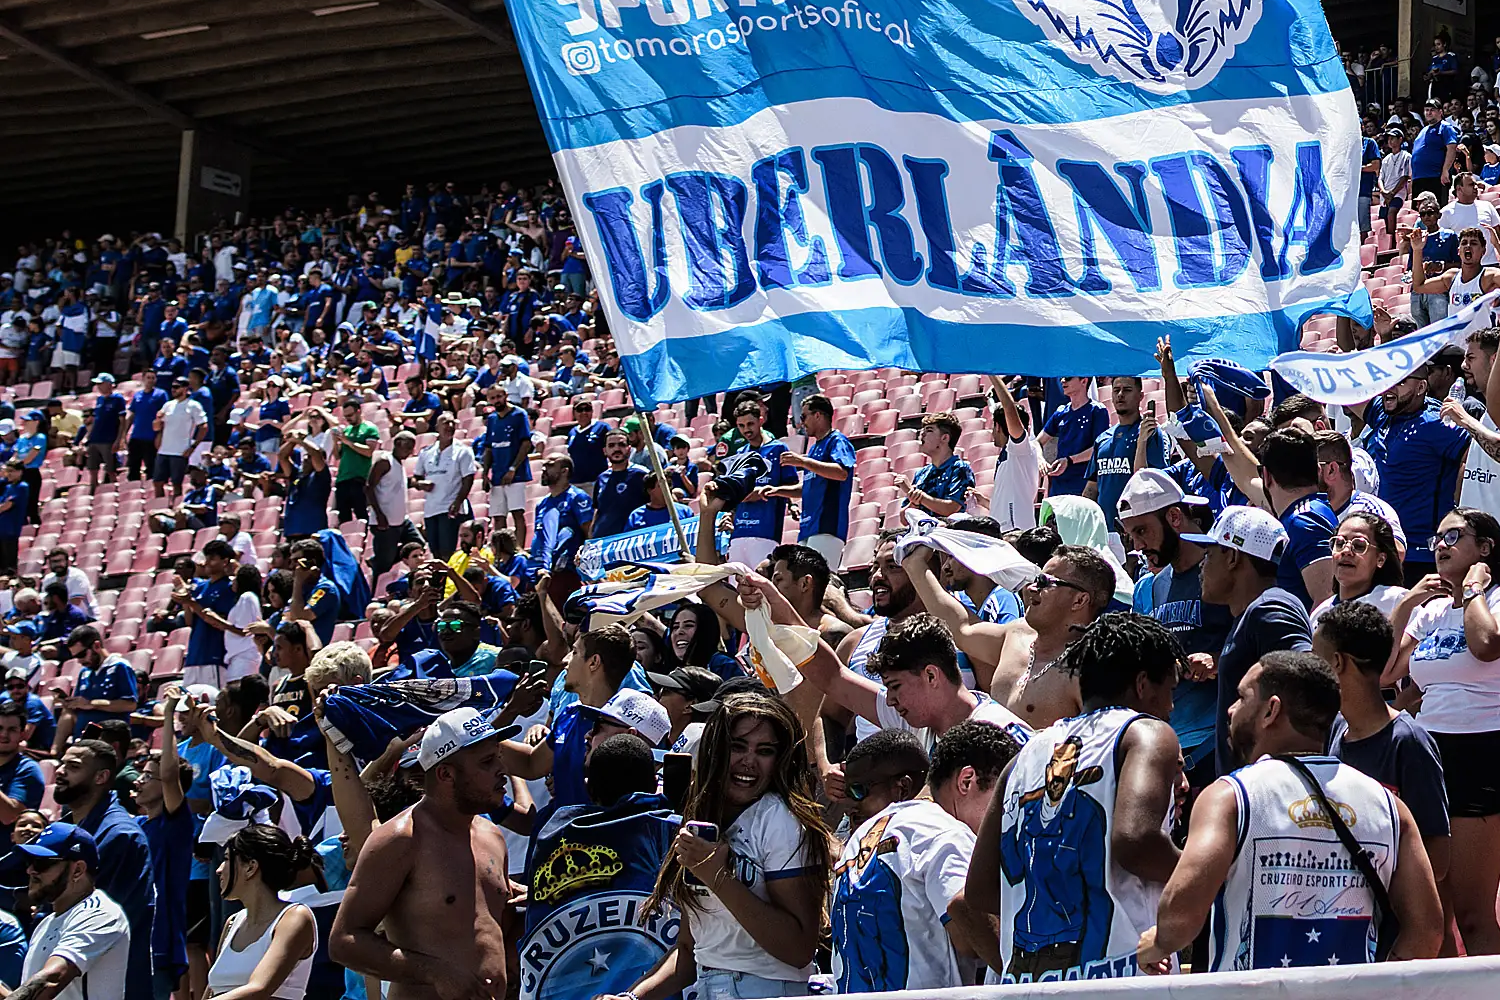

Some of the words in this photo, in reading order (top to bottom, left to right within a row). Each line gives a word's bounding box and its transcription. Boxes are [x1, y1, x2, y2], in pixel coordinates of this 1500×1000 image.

[582, 130, 1349, 322] UBERLÂNDIA
[1096, 457, 1131, 470] TENDA
[603, 531, 658, 564] CHINA
[661, 520, 700, 555] AZU
[622, 708, 645, 724] 1977
[434, 740, 458, 759] 1921
[1261, 873, 1303, 886] CRUZEIRO
[1305, 875, 1349, 888] ESPORTE
